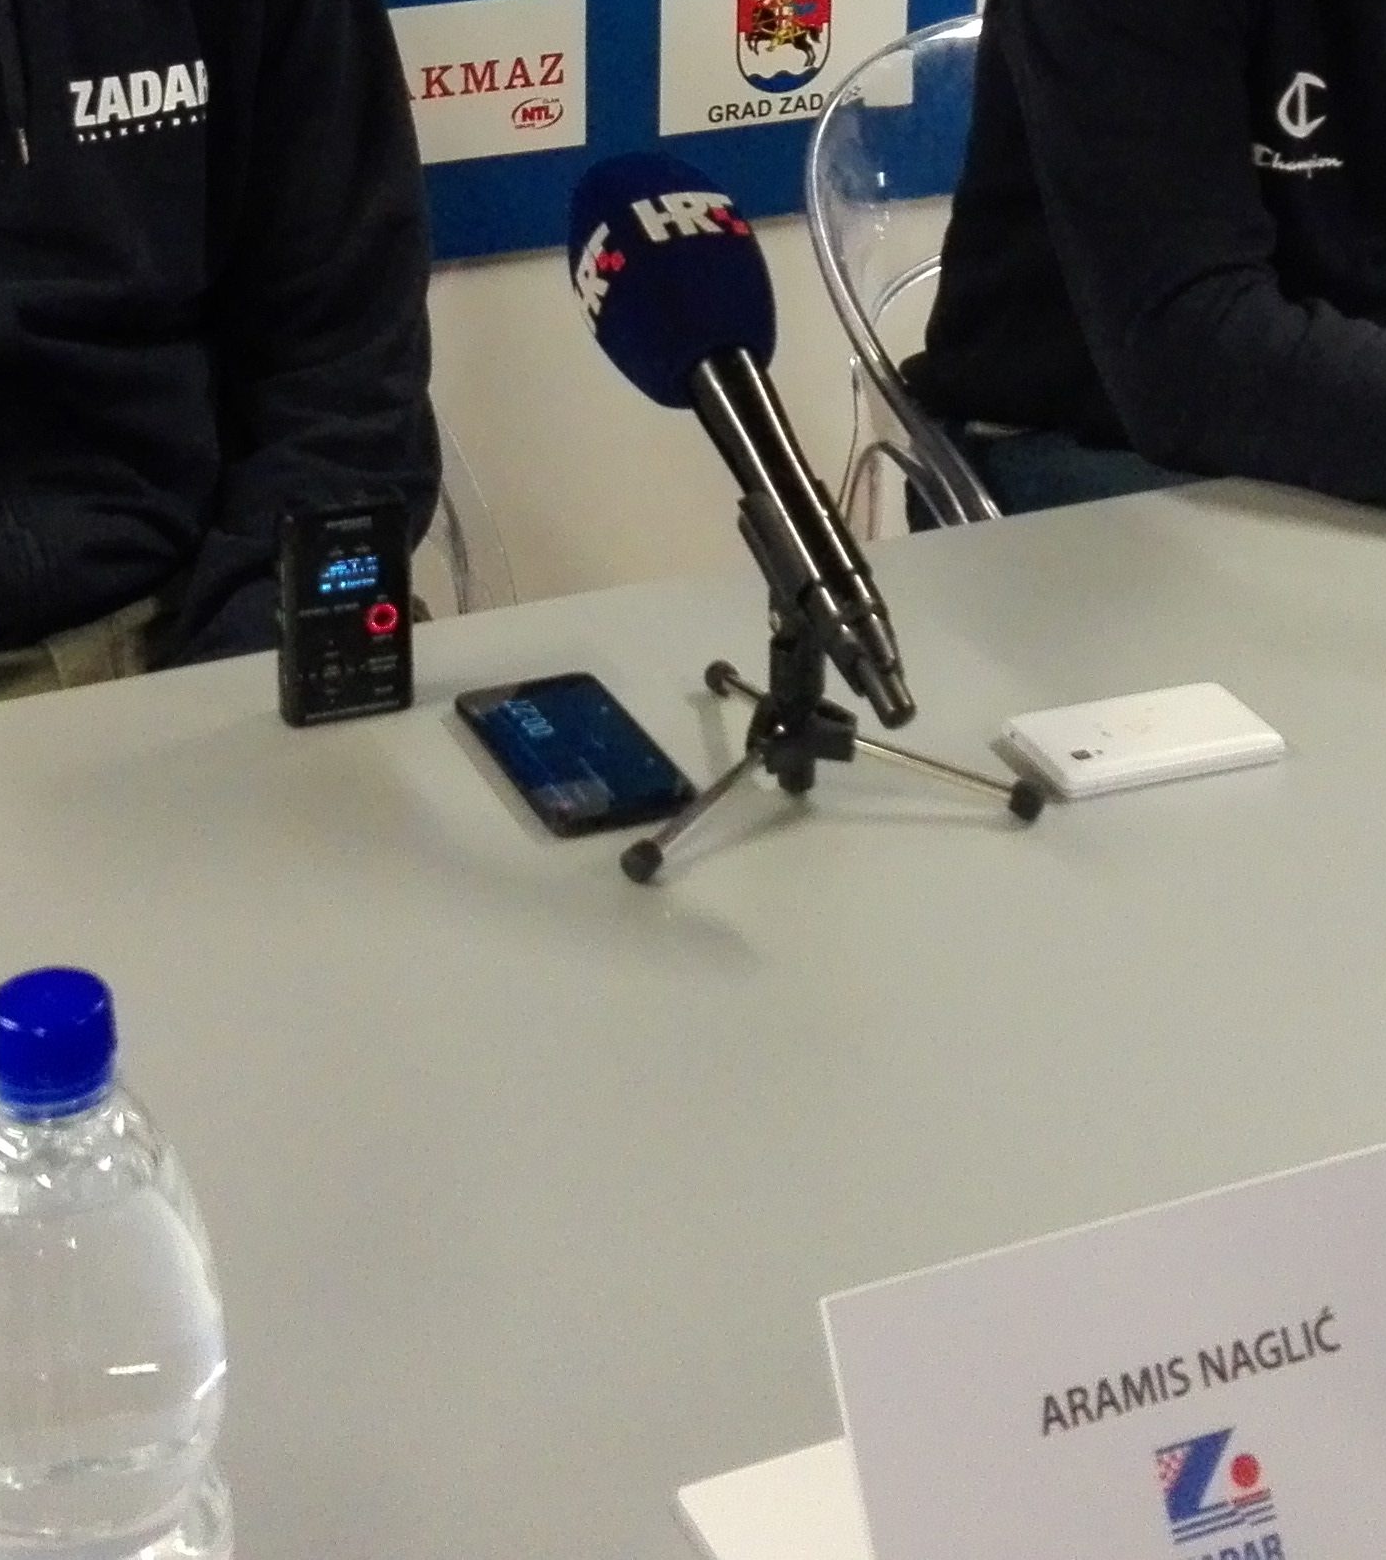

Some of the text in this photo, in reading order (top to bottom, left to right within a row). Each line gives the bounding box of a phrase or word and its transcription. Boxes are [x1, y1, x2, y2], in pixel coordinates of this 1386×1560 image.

[708, 100, 772, 123] GRAD
[1042, 1306, 1342, 1437] ARAMIS NAGLIĆ
